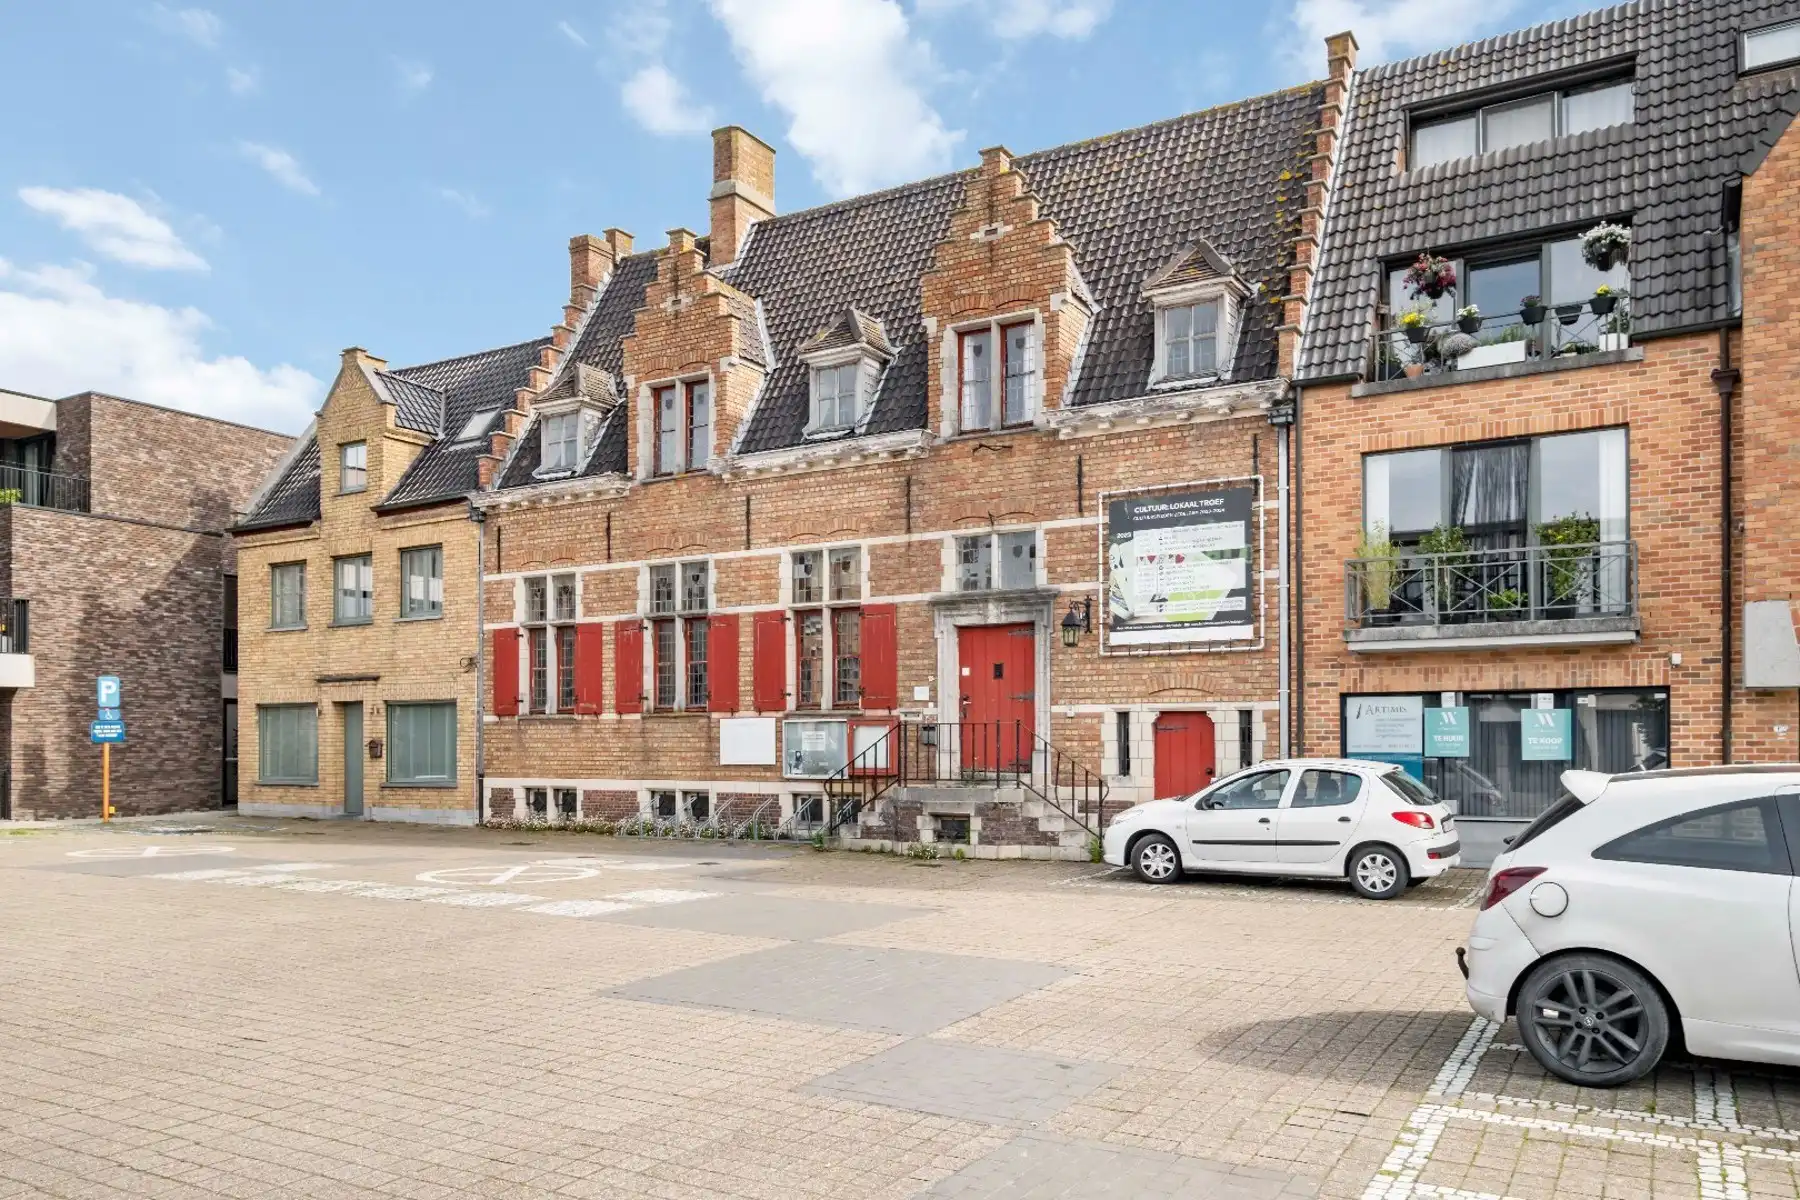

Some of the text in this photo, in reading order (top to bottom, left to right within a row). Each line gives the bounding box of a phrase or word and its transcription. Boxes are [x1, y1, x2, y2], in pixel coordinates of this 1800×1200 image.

[1134, 498, 1225, 514] CULTUUR: LOKAAL TROEF
[100, 680, 117, 703] P
[1432, 734, 1464, 742] TE HUUR
[1527, 736, 1563, 745] TE KOOP
